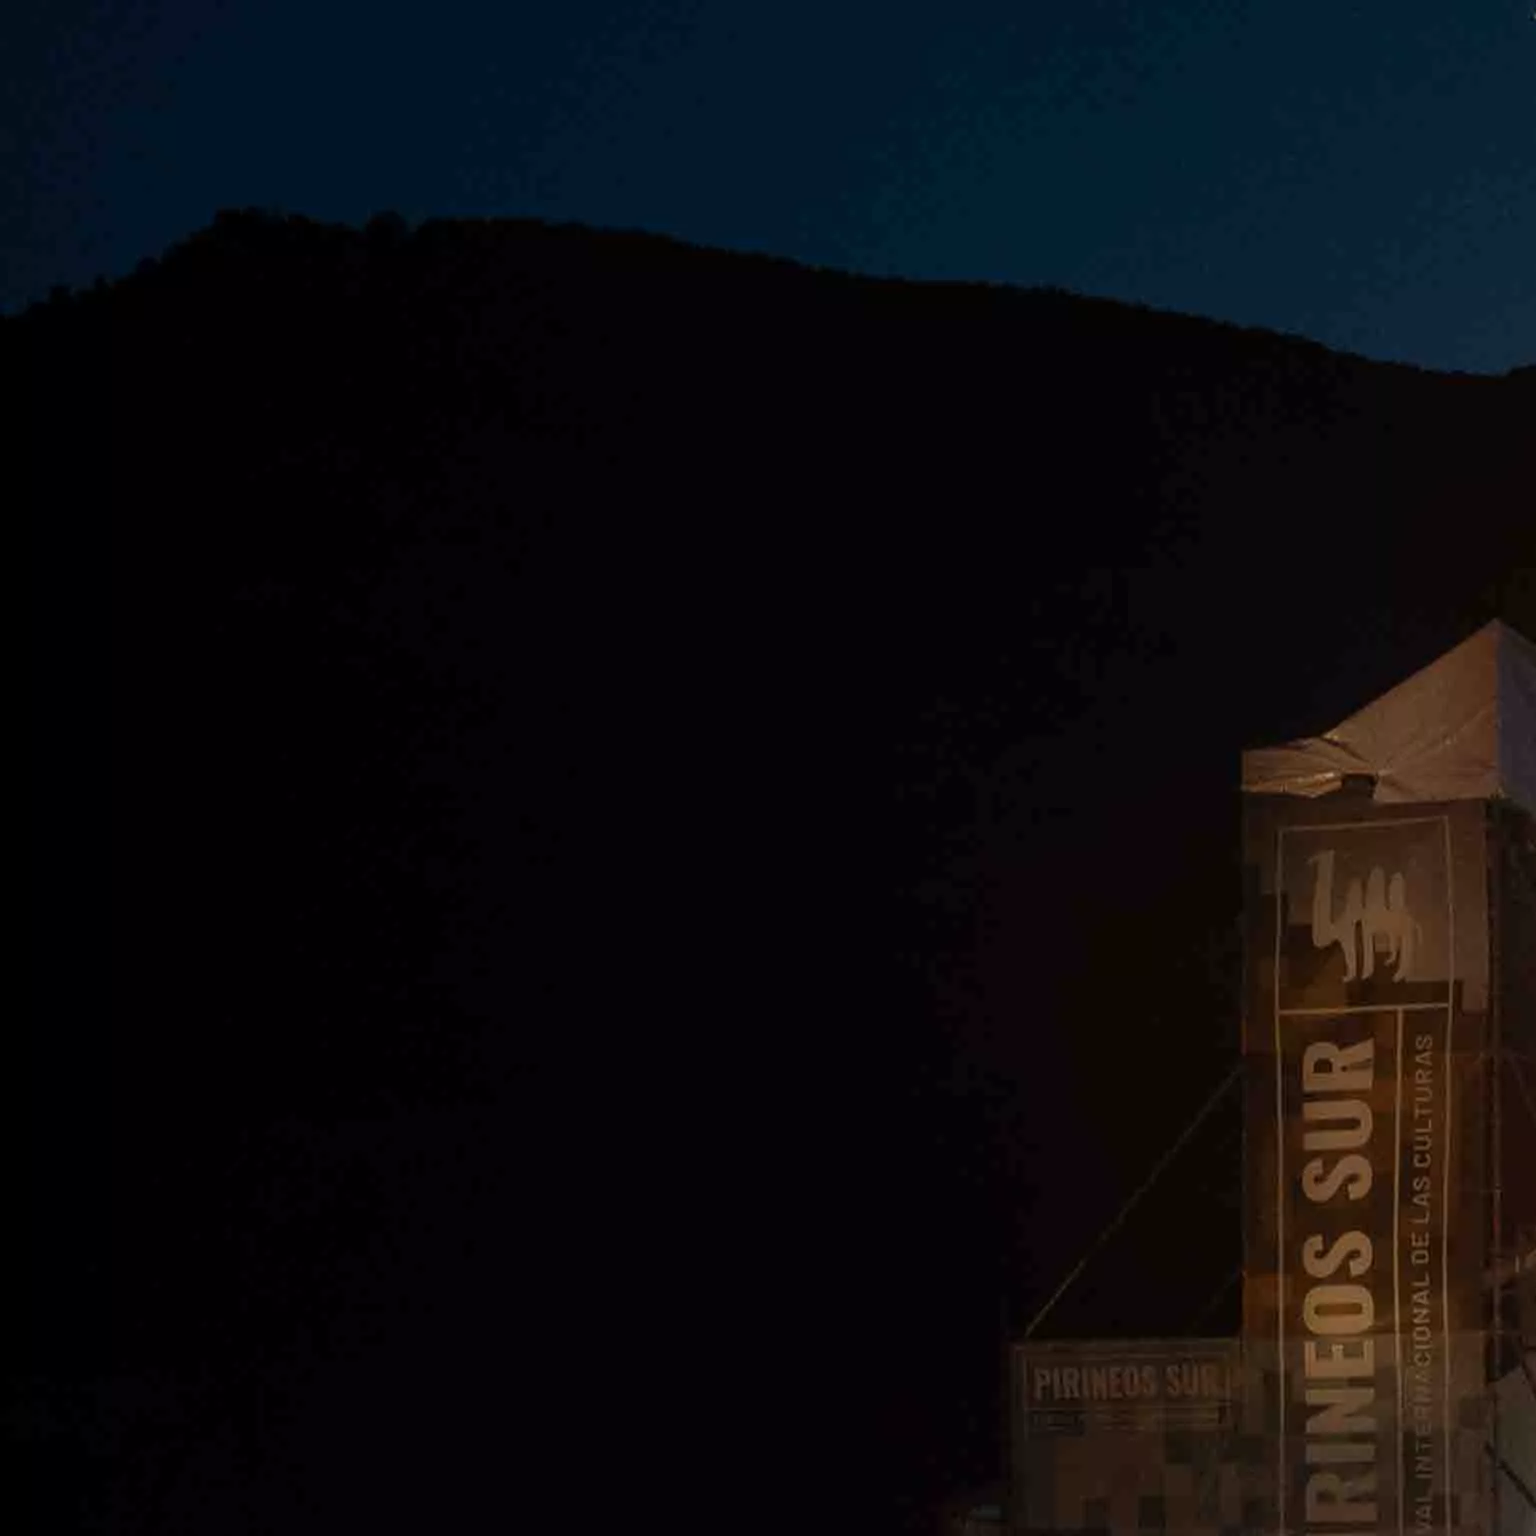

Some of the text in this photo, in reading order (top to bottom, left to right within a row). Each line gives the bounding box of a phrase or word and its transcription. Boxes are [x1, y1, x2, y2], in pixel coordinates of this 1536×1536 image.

[1302, 1036, 1376, 1203] SUR
[1413, 1033, 1434, 1168] CULTURAS
[1412, 1175, 1432, 1225] LAS
[1410, 1231, 1430, 1265] DE
[1033, 1361, 1220, 1401] PIRINEOS SUR
